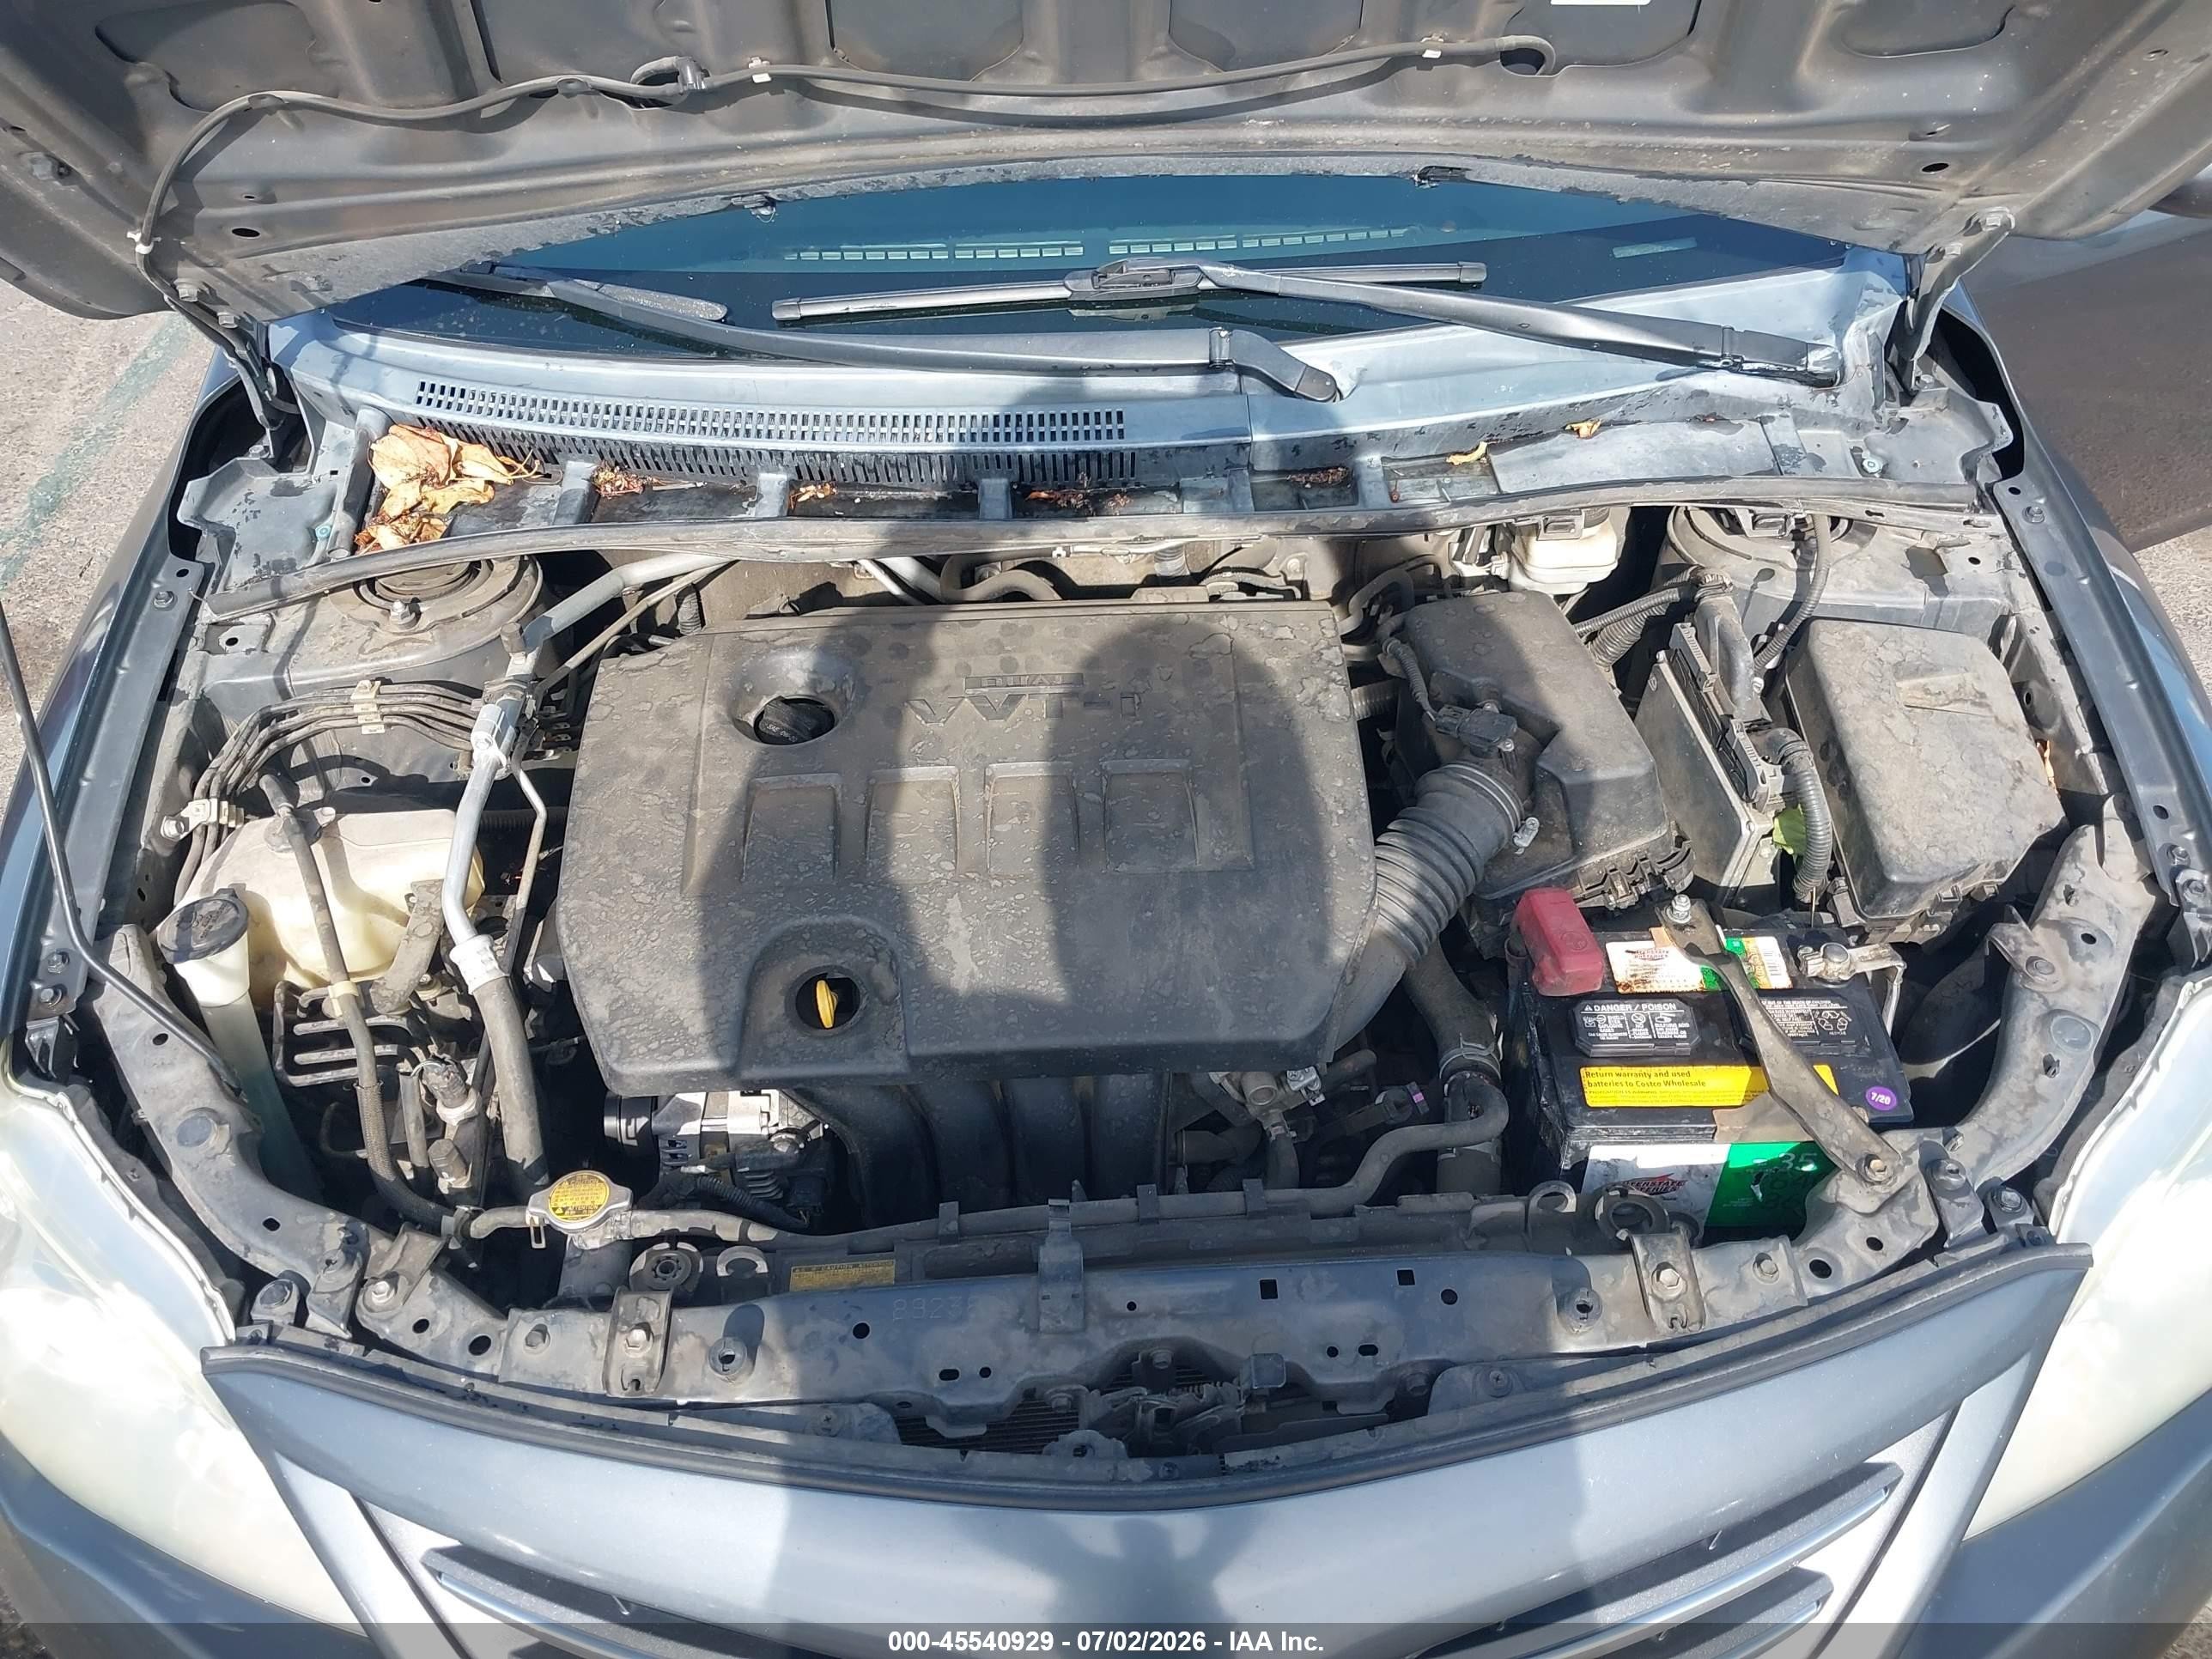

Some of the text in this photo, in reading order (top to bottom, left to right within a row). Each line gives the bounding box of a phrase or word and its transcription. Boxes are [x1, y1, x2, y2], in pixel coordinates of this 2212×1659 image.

[1594, 1003, 1632, 1012] DANGER
[1641, 1002, 1677, 1011] POISON
[1870, 1091, 1892, 1106] 7/20
